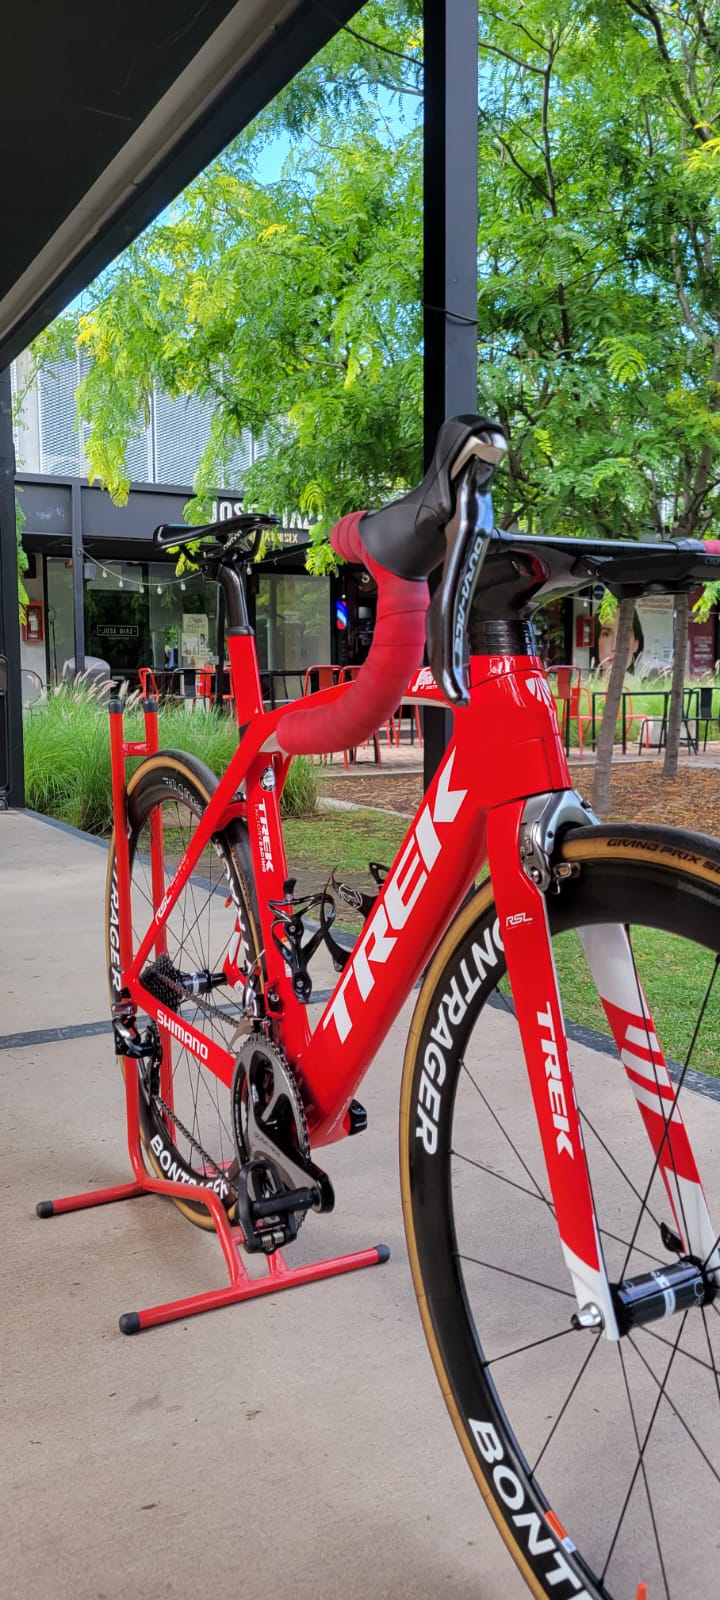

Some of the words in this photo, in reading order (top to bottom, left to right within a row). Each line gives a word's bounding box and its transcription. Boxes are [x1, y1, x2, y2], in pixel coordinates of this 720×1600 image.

[258, 797, 275, 873] TREK
[606, 838, 659, 852] GRAND
[660, 846, 701, 865] PRIX
[110, 856, 122, 992] RAGER
[322, 746, 469, 1044] TREK
[505, 911, 534, 928] RSL
[156, 1009, 209, 1061] SHIMANO
[536, 1001, 575, 1161] TREK
[468, 1418, 594, 1600] BONT
